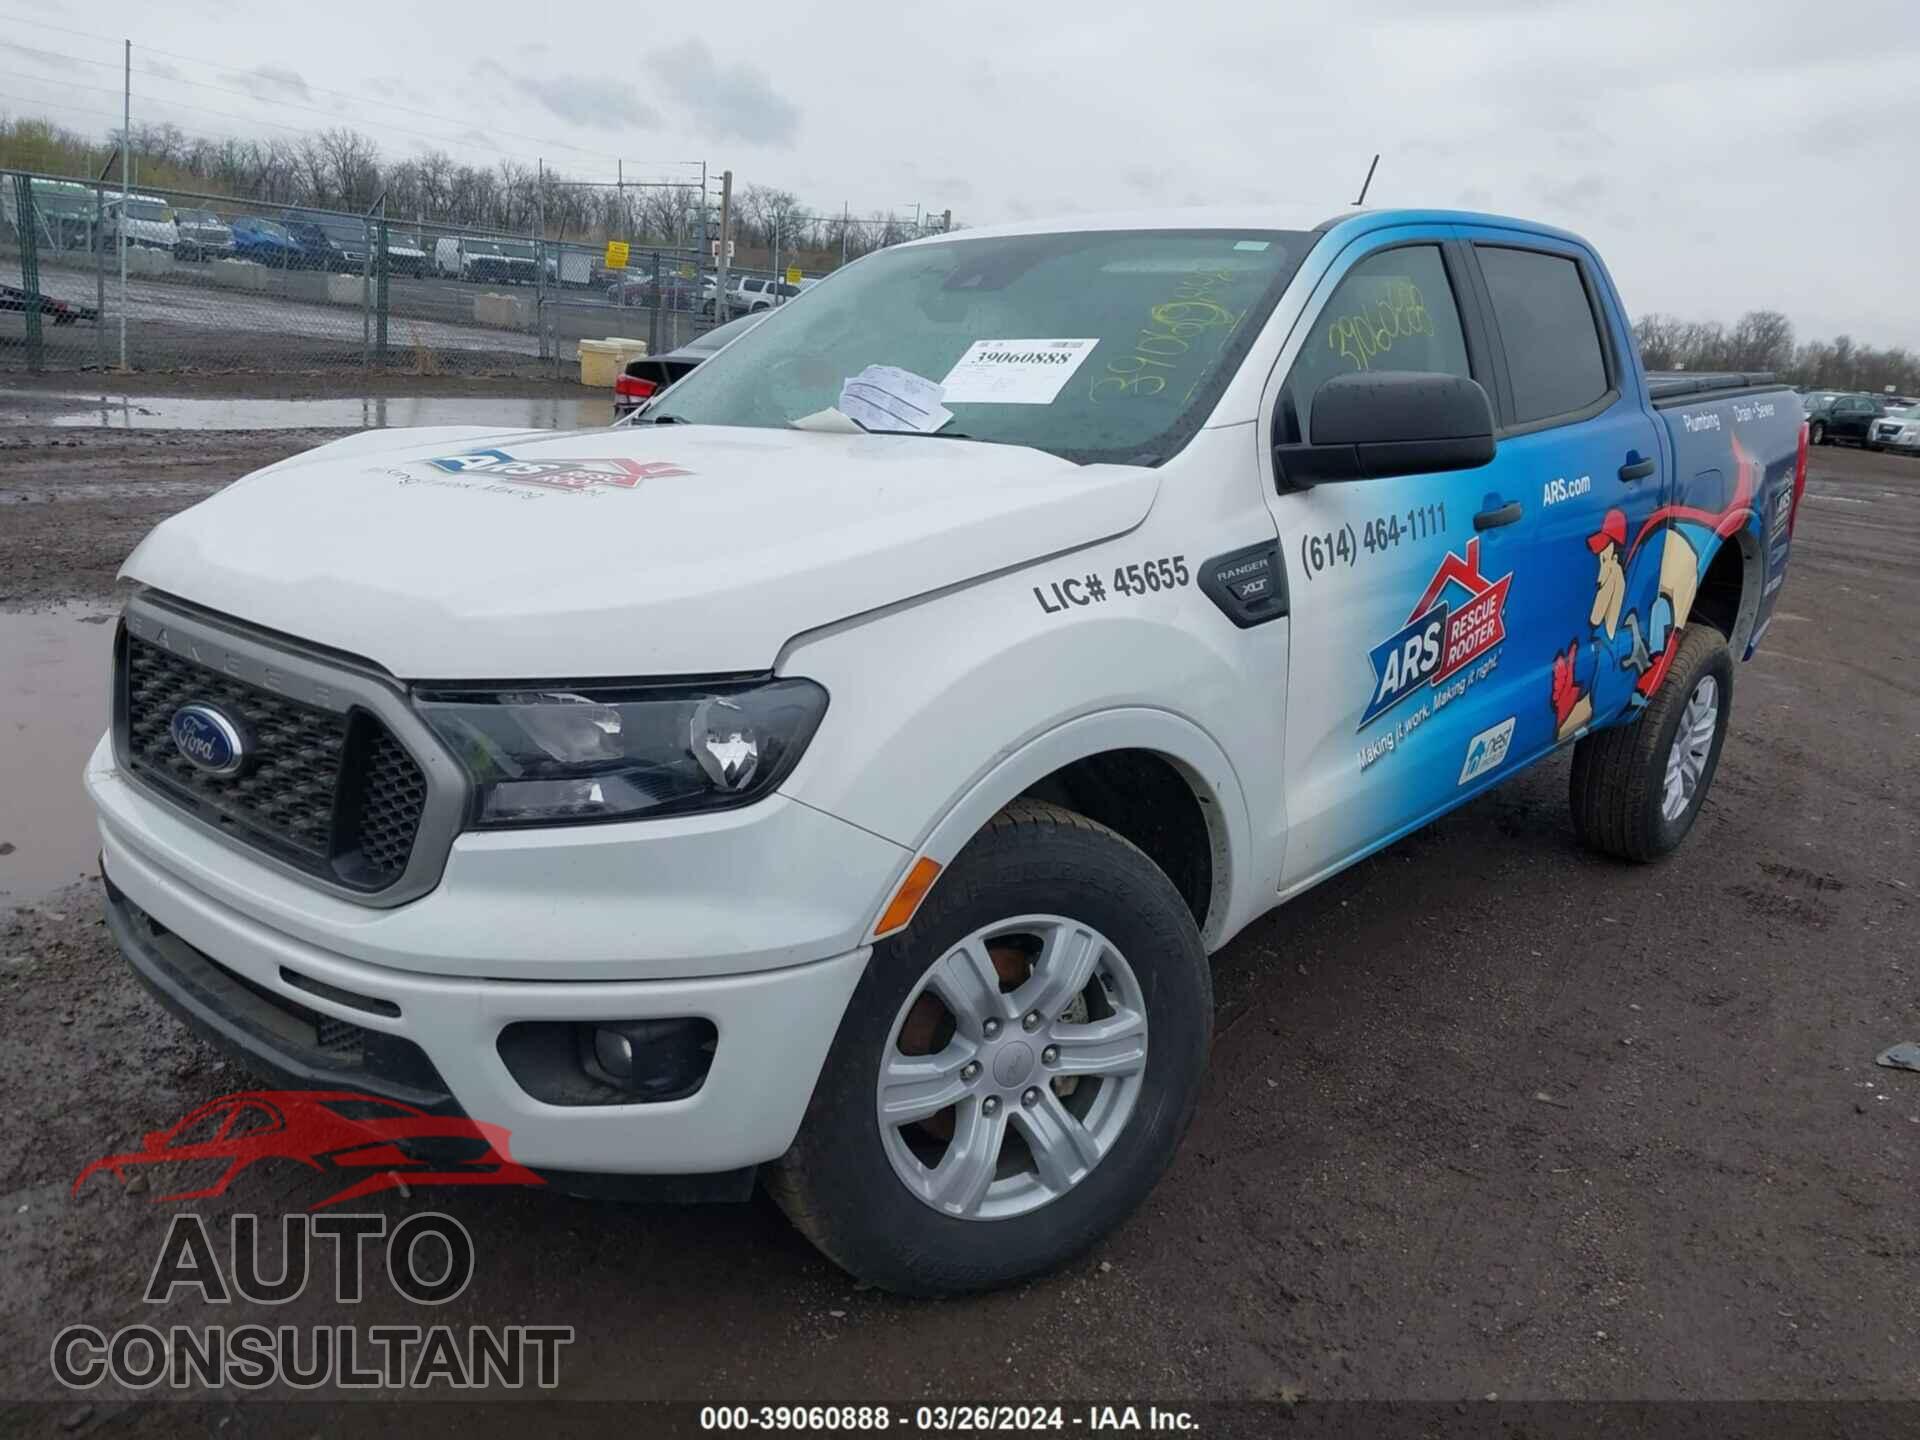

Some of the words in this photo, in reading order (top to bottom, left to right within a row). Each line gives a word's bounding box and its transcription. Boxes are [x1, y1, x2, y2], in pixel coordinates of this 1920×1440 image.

[971, 351, 1073, 364] 39060888
[1543, 475, 1591, 507] ARS.com
[1302, 522, 1357, 581] (614)
[1363, 501, 1446, 555] 464-1111
[1033, 573, 1107, 614] LIC#
[1112, 555, 1189, 597] 45655
[1216, 558, 1269, 582] RANGER
[1240, 578, 1268, 596] XLT
[1451, 593, 1497, 642] RESCUE
[1375, 621, 1441, 704] ARS
[1446, 619, 1496, 668] ROOTER
[179, 715, 216, 760] Ford
[1357, 732, 1395, 773] Making
[1432, 678, 1466, 712] Making
